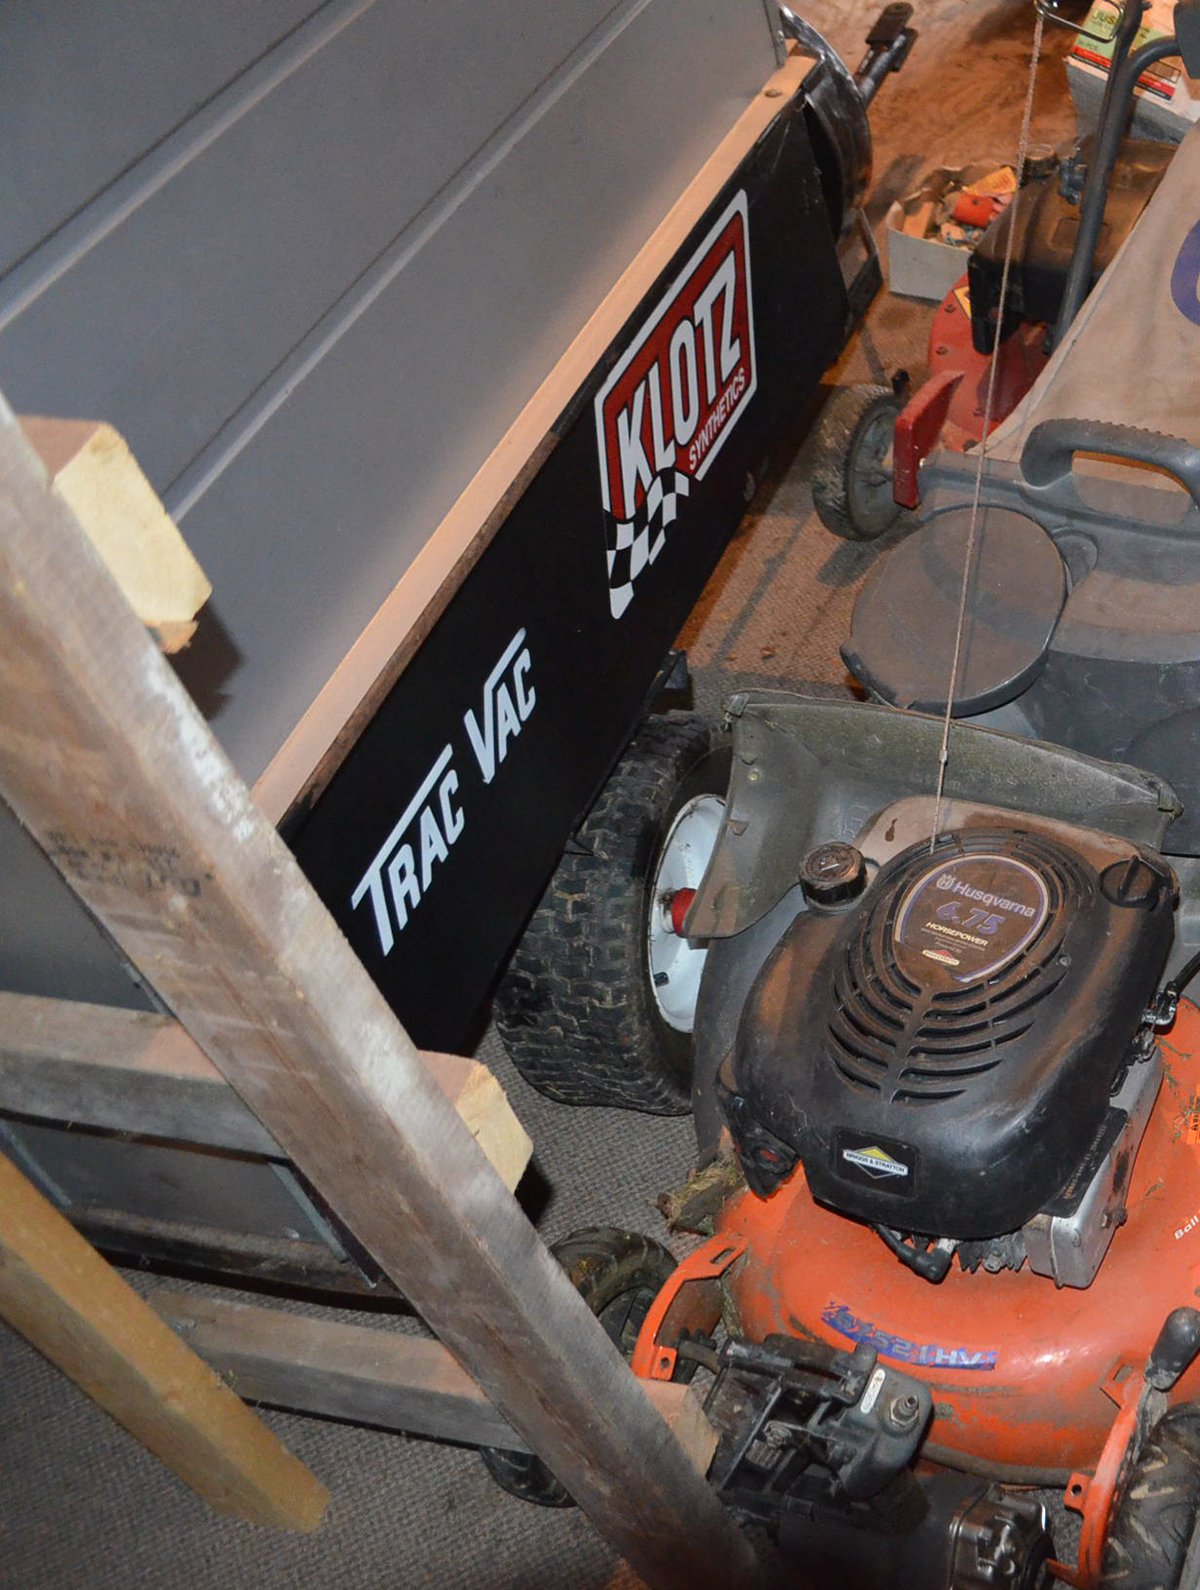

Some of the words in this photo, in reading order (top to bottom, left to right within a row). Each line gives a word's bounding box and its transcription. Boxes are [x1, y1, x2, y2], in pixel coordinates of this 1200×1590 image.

[617, 250, 741, 519] KLOTZ
[688, 366, 746, 471] SYNTHETICS
[351, 743, 465, 957] TRAC
[463, 627, 536, 785] VAC
[925, 922, 989, 946] HORSEPOWER
[952, 881, 1037, 918] Husqvarna
[1174, 1215, 1200, 1240] Ball
